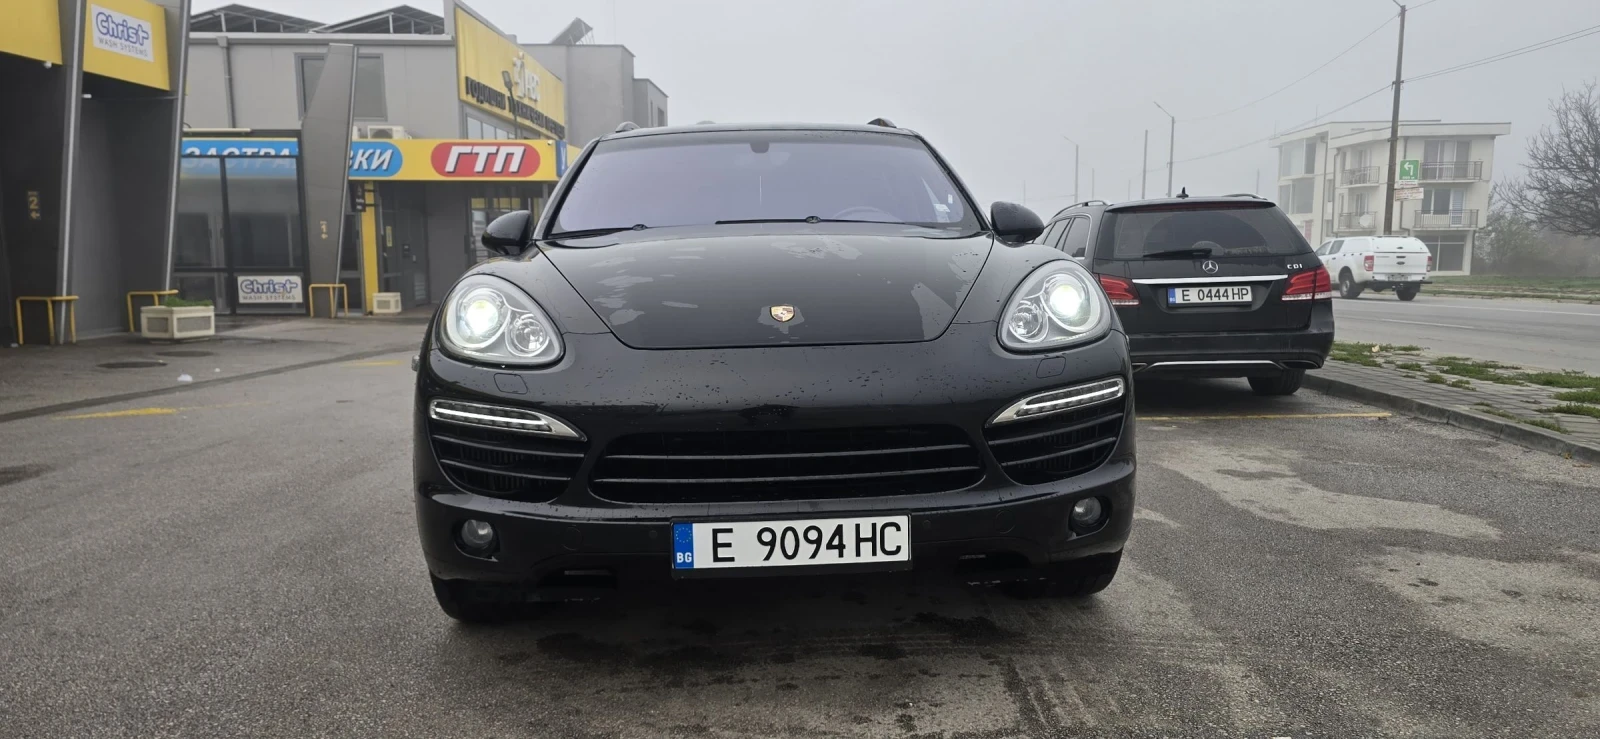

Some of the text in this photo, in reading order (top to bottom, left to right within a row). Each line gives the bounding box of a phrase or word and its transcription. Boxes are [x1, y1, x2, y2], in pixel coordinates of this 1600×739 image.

[95, 11, 150, 46] Christ
[444, 145, 526, 174] ГТП
[29, 196, 39, 209] 2
[240, 279, 298, 294] Christ
[1181, 289, 1191, 302] E
[711, 527, 736, 563] E
[676, 552, 693, 564] BG
